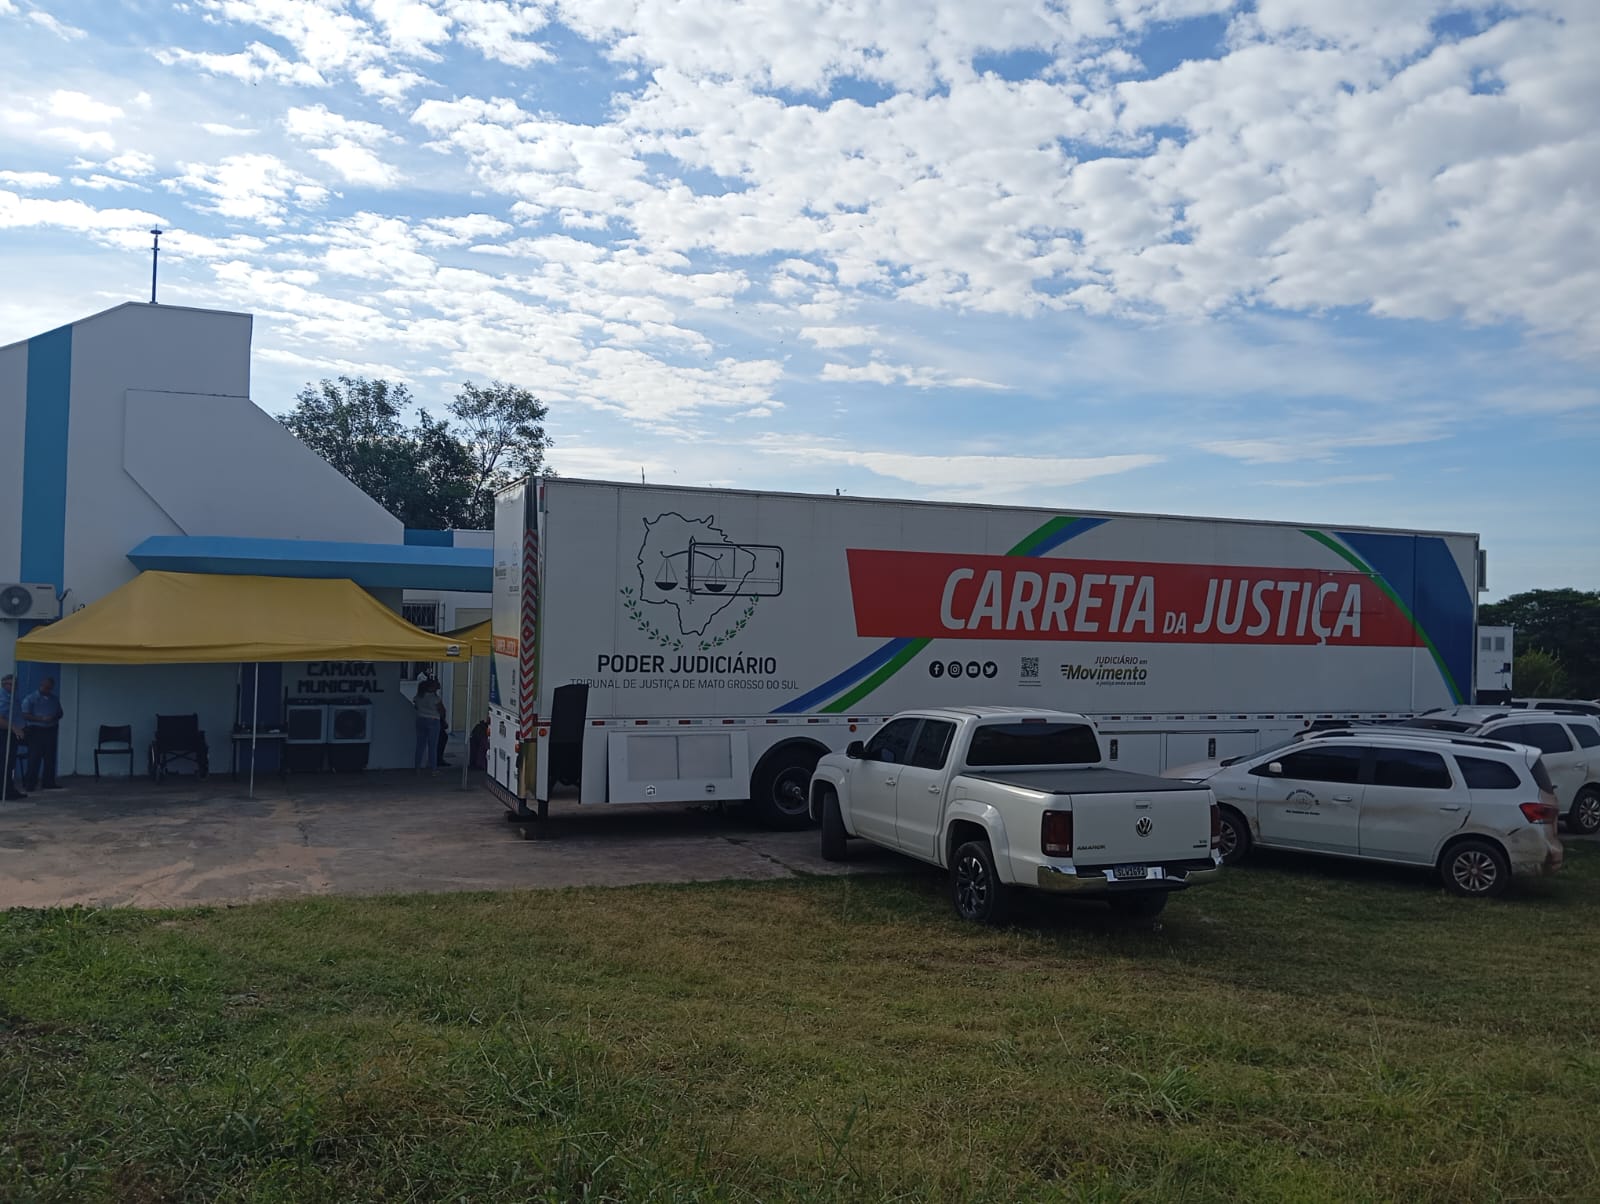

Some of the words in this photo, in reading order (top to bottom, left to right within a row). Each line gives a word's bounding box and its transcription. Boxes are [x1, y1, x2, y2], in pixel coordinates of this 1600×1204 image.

[940, 567, 1155, 633] CARRETA
[1163, 611, 1187, 634] DA
[1193, 578, 1361, 645] JUSTIÇA
[598, 654, 665, 673] PODER
[670, 651, 777, 674] JUDICIÁRIO
[1095, 654, 1139, 665] JUDICIÁRIO
[1067, 664, 1147, 680] Movimento
[297, 679, 385, 693] MUNICIPAL
[569, 678, 620, 689] TRIBUNAL
[623, 679, 637, 689] DE
[640, 679, 680, 691] JUSTIÇA
[682, 679, 695, 689] DE
[698, 679, 725, 689] MATO
[727, 679, 764, 689] GROSSO
[766, 680, 779, 689] DO
[781, 680, 800, 690] SUL
